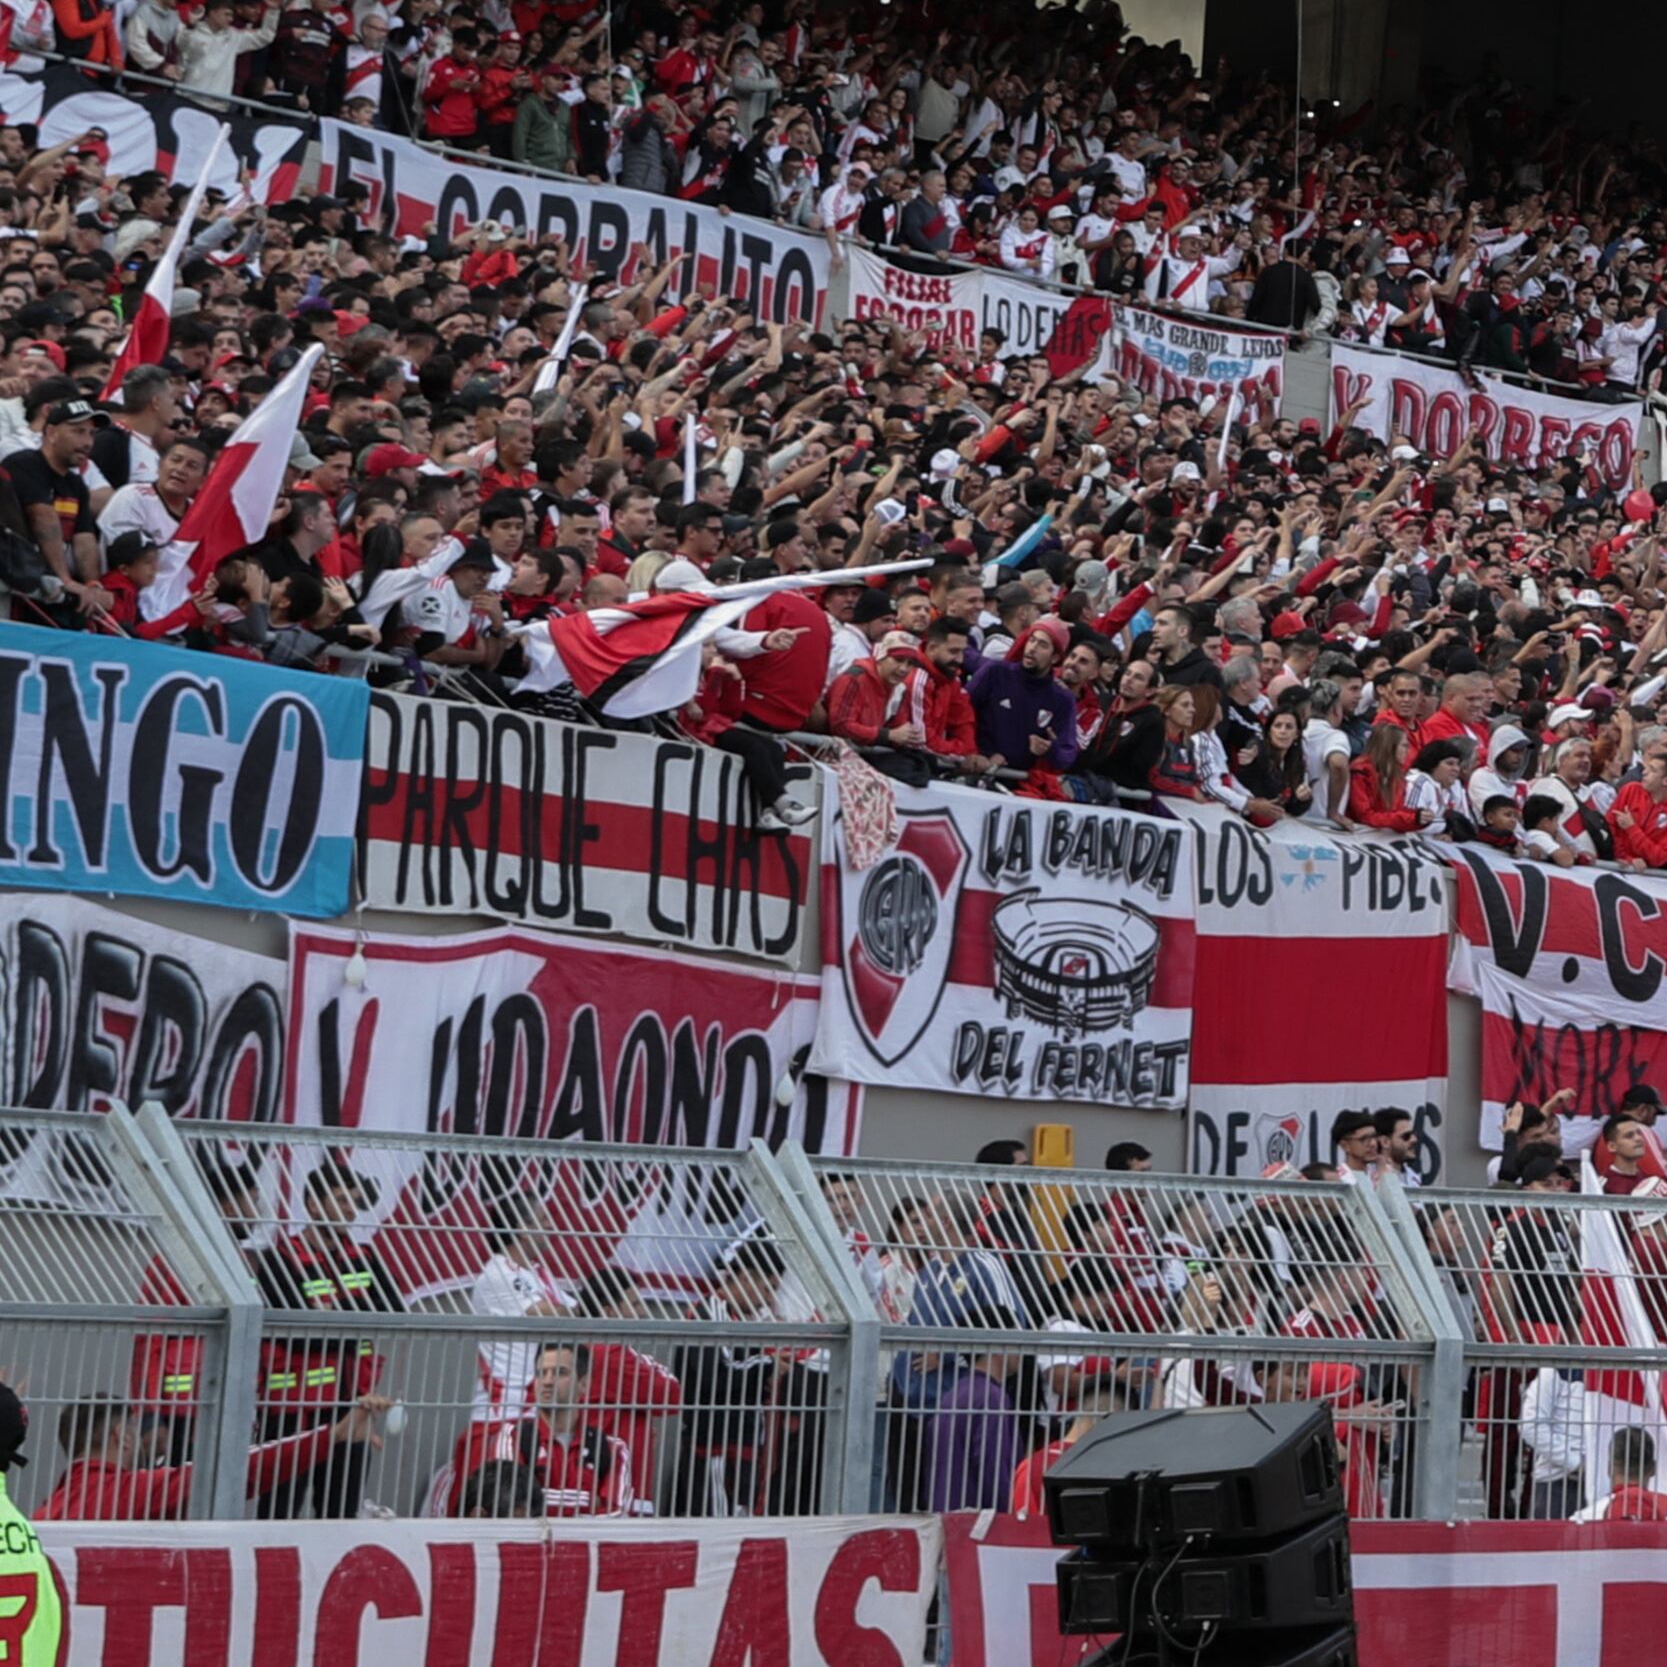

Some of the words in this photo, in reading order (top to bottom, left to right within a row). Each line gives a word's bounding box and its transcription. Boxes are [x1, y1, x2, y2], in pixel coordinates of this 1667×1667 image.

[1132, 310, 1166, 338] MAS
[1392, 377, 1635, 493] DORREGO
[365, 691, 617, 932] PARQUE
[981, 806, 1034, 887] LA
[1043, 809, 1183, 900] BANDA
[1197, 816, 1276, 909] LOS
[1461, 845, 1580, 986] V.
[953, 1020, 1026, 1094] DEL
[1032, 1037, 1191, 1106] FERNET
